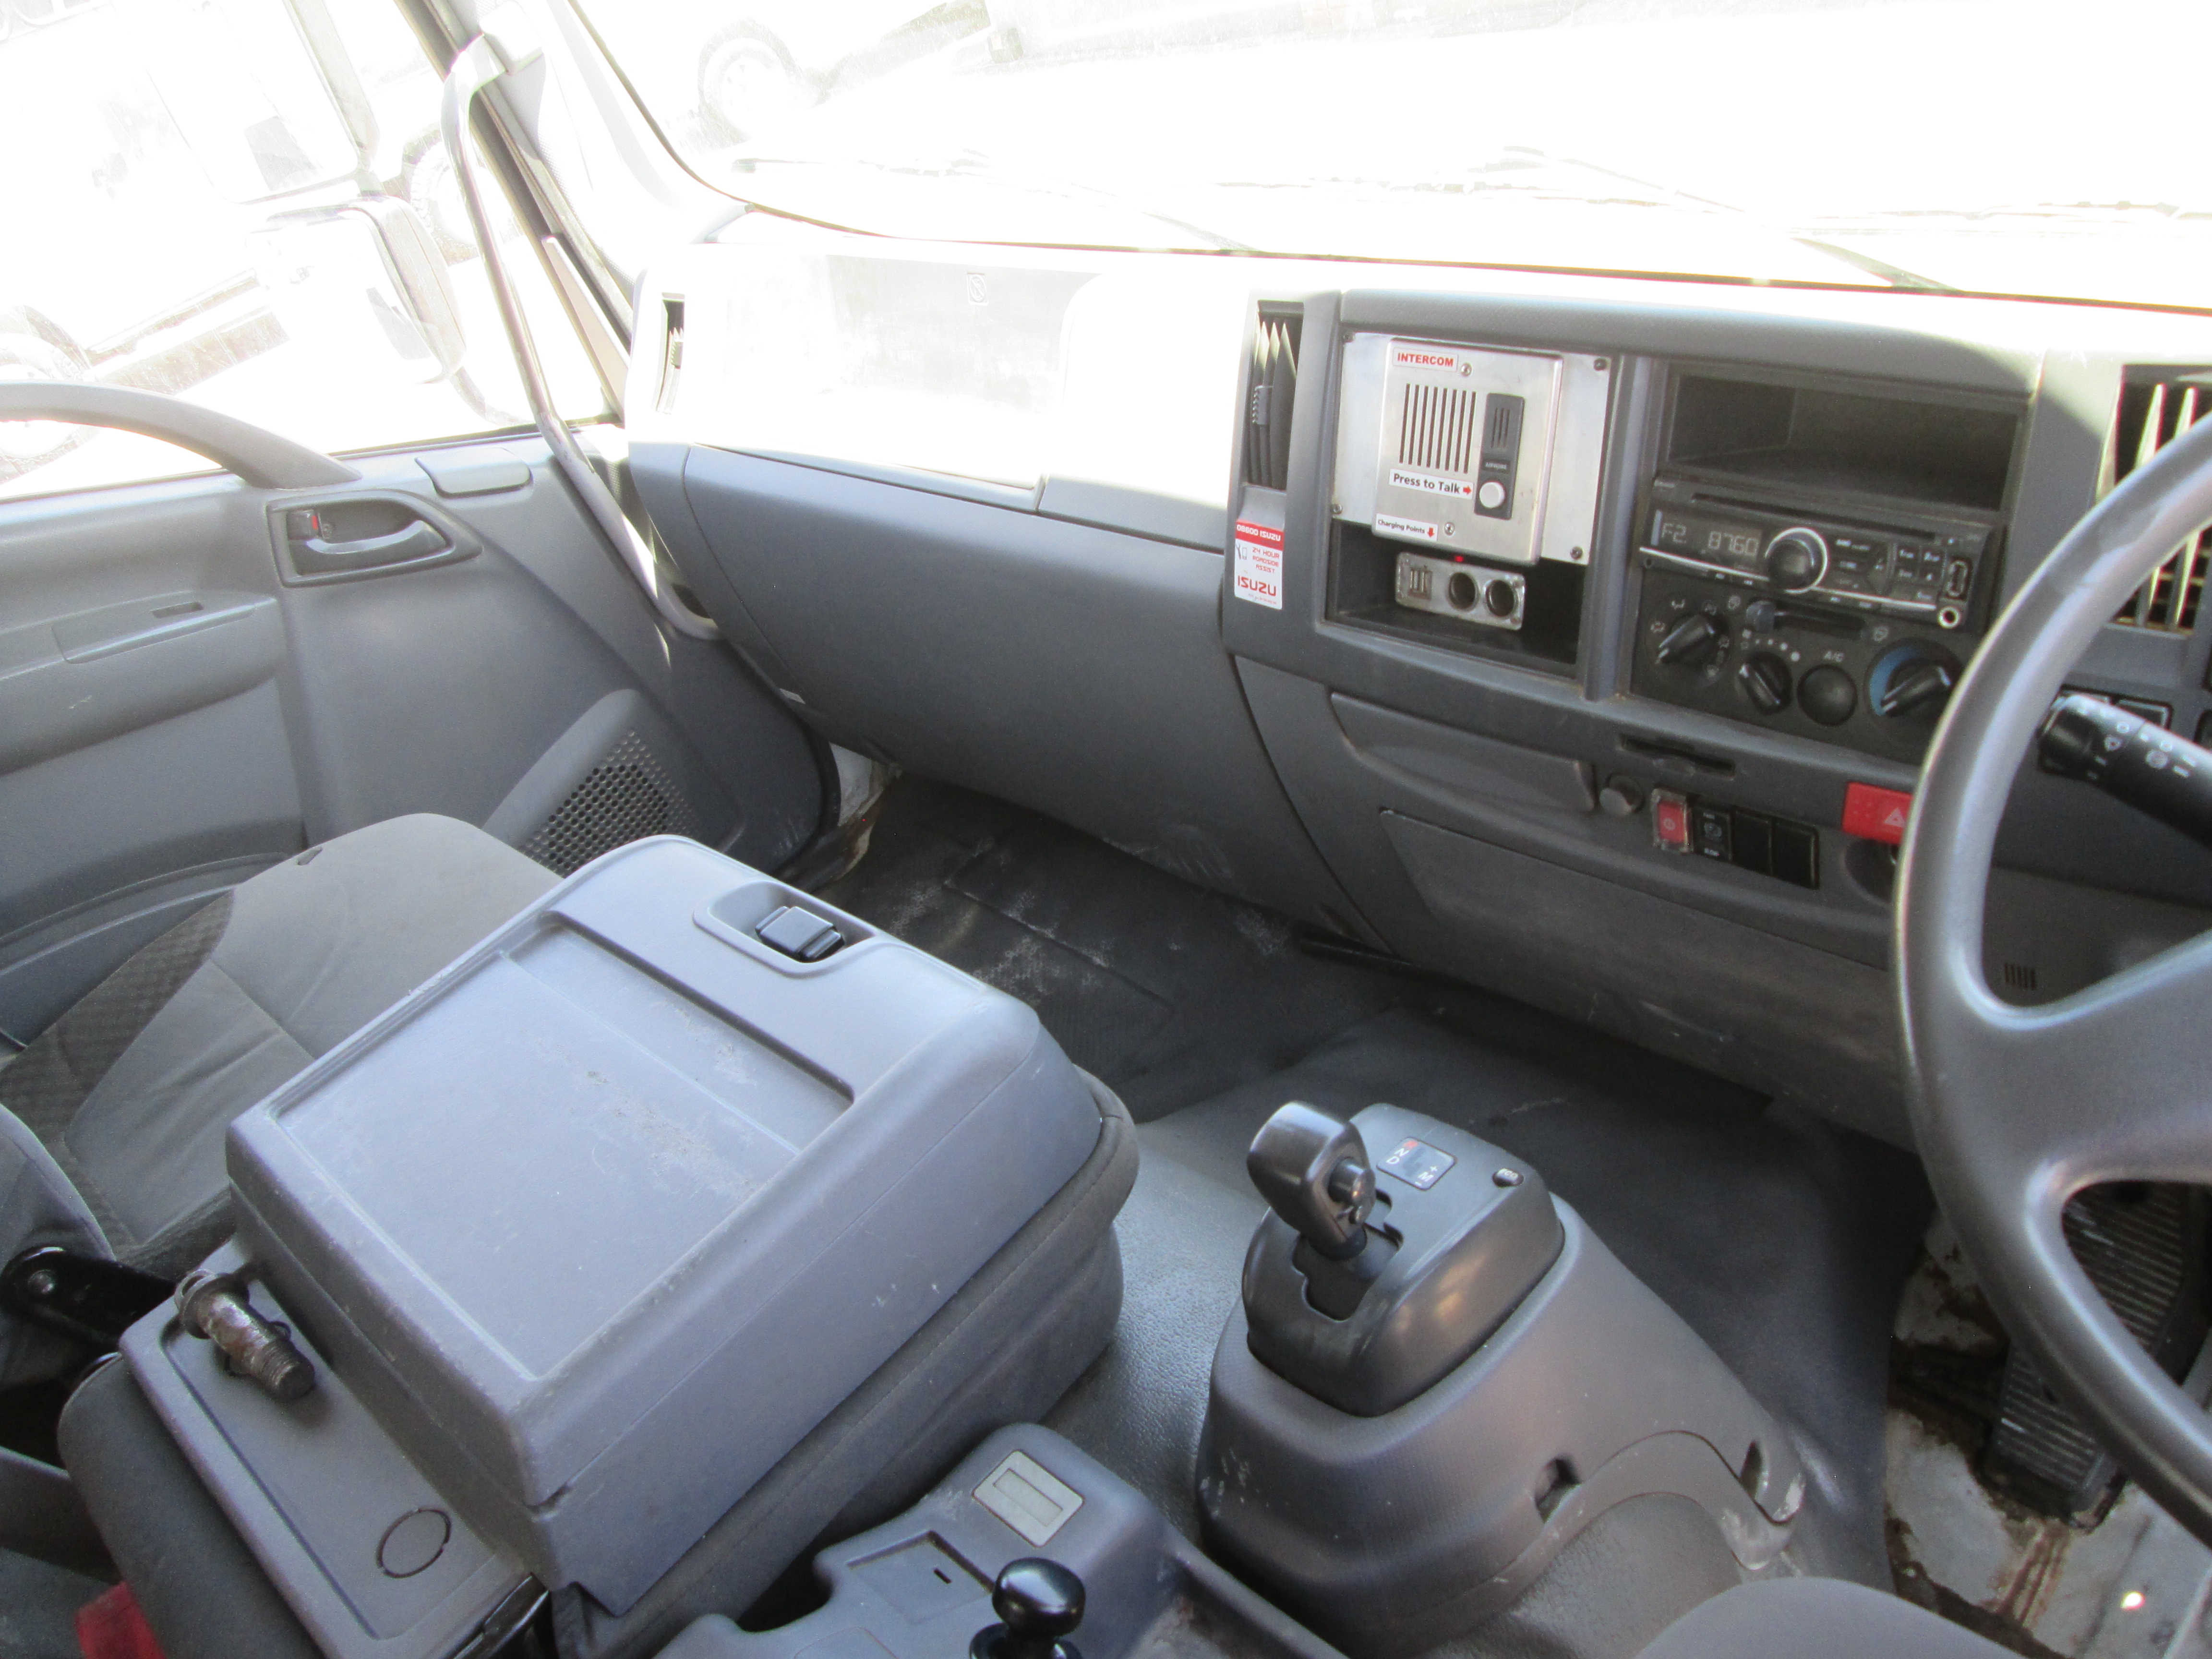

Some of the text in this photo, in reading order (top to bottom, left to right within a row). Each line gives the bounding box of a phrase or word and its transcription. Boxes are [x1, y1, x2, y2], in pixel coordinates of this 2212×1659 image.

[1397, 352, 1454, 367] INTERCOM
[1394, 473, 1460, 493] Press to Talk
[1378, 518, 1425, 534] Charging Points
[1260, 530, 1281, 541] ISUZU
[1661, 522, 1686, 544] F2
[1263, 549, 1280, 559] HOUR
[1252, 555, 1279, 567] ROADSIDE
[1256, 564, 1275, 574] ASSIST
[1238, 575, 1277, 597] ISUZU
[1824, 651, 1844, 662] A/C
[1393, 1148, 1410, 1157] N
[1386, 1155, 1400, 1164] D
[1418, 1171, 1434, 1182] M
